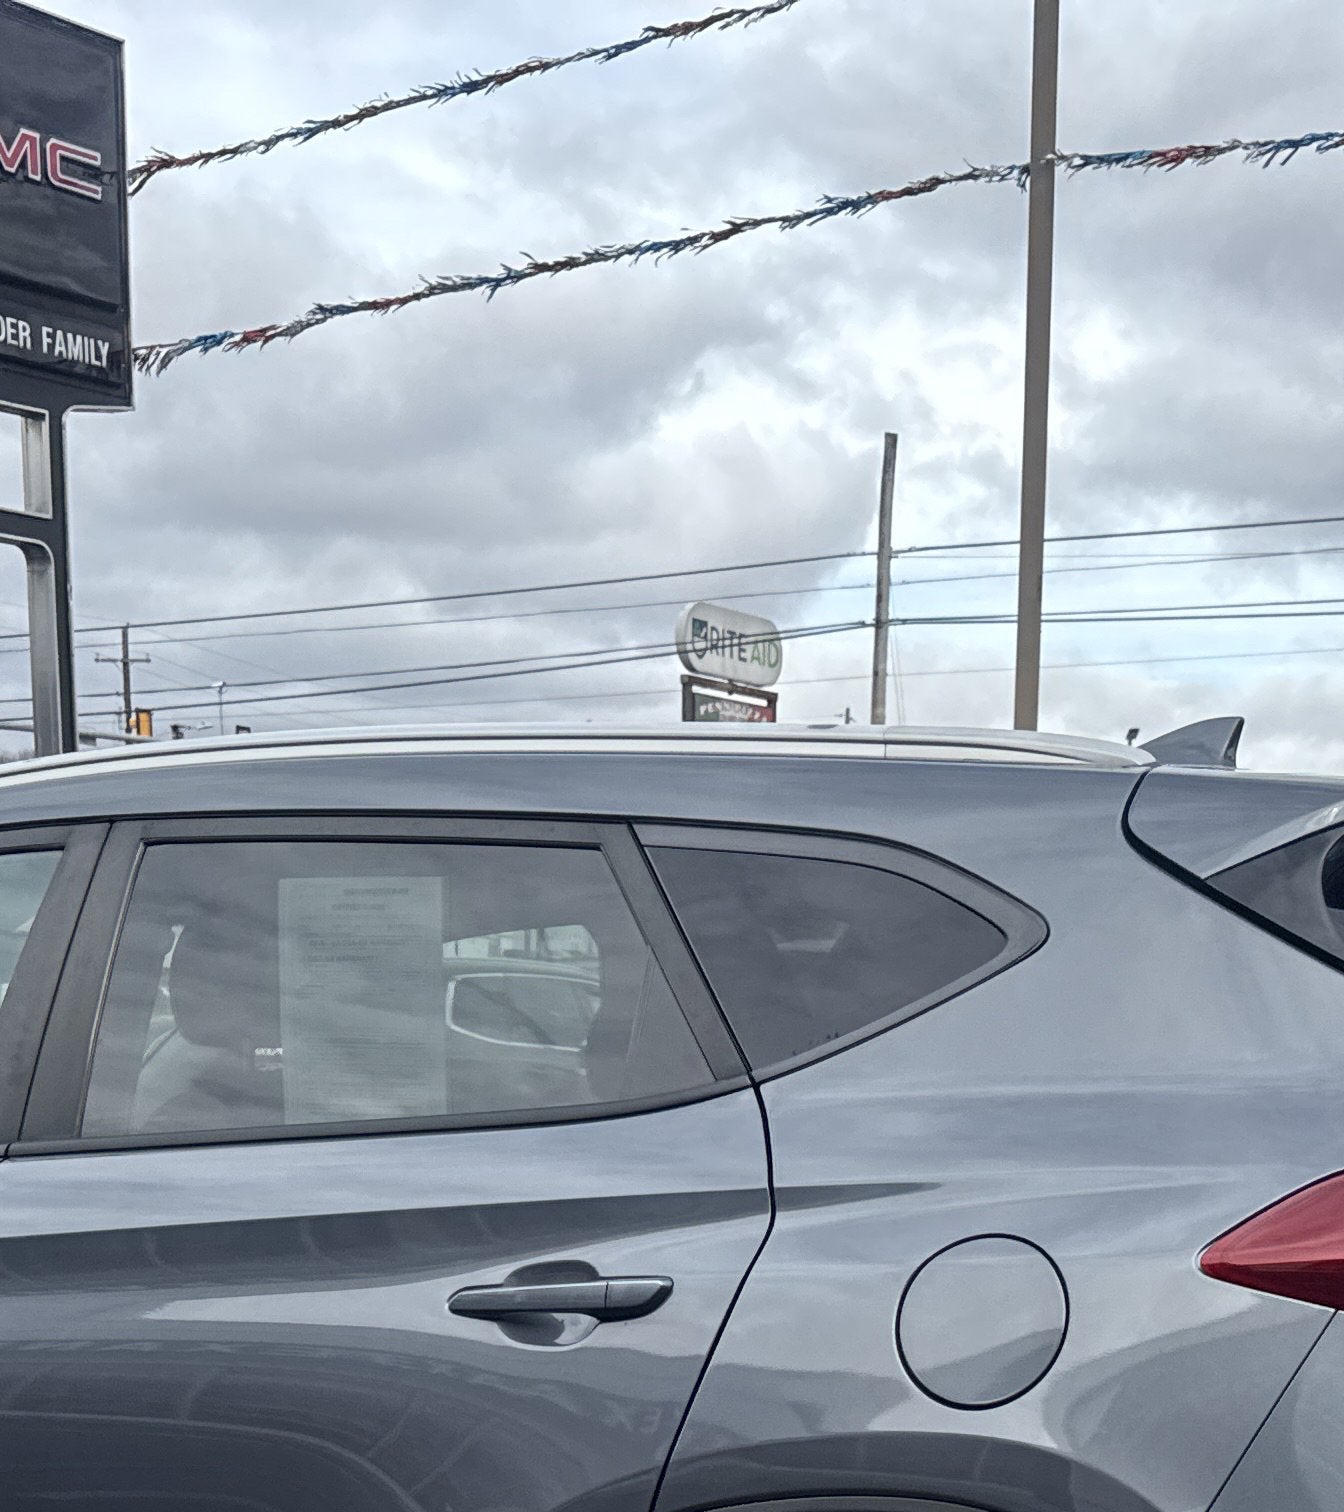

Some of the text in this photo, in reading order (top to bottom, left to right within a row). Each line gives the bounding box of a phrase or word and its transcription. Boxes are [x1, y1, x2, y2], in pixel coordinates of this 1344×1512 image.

[41, 325, 110, 368] FAMILY
[710, 626, 779, 669] RITE AID
